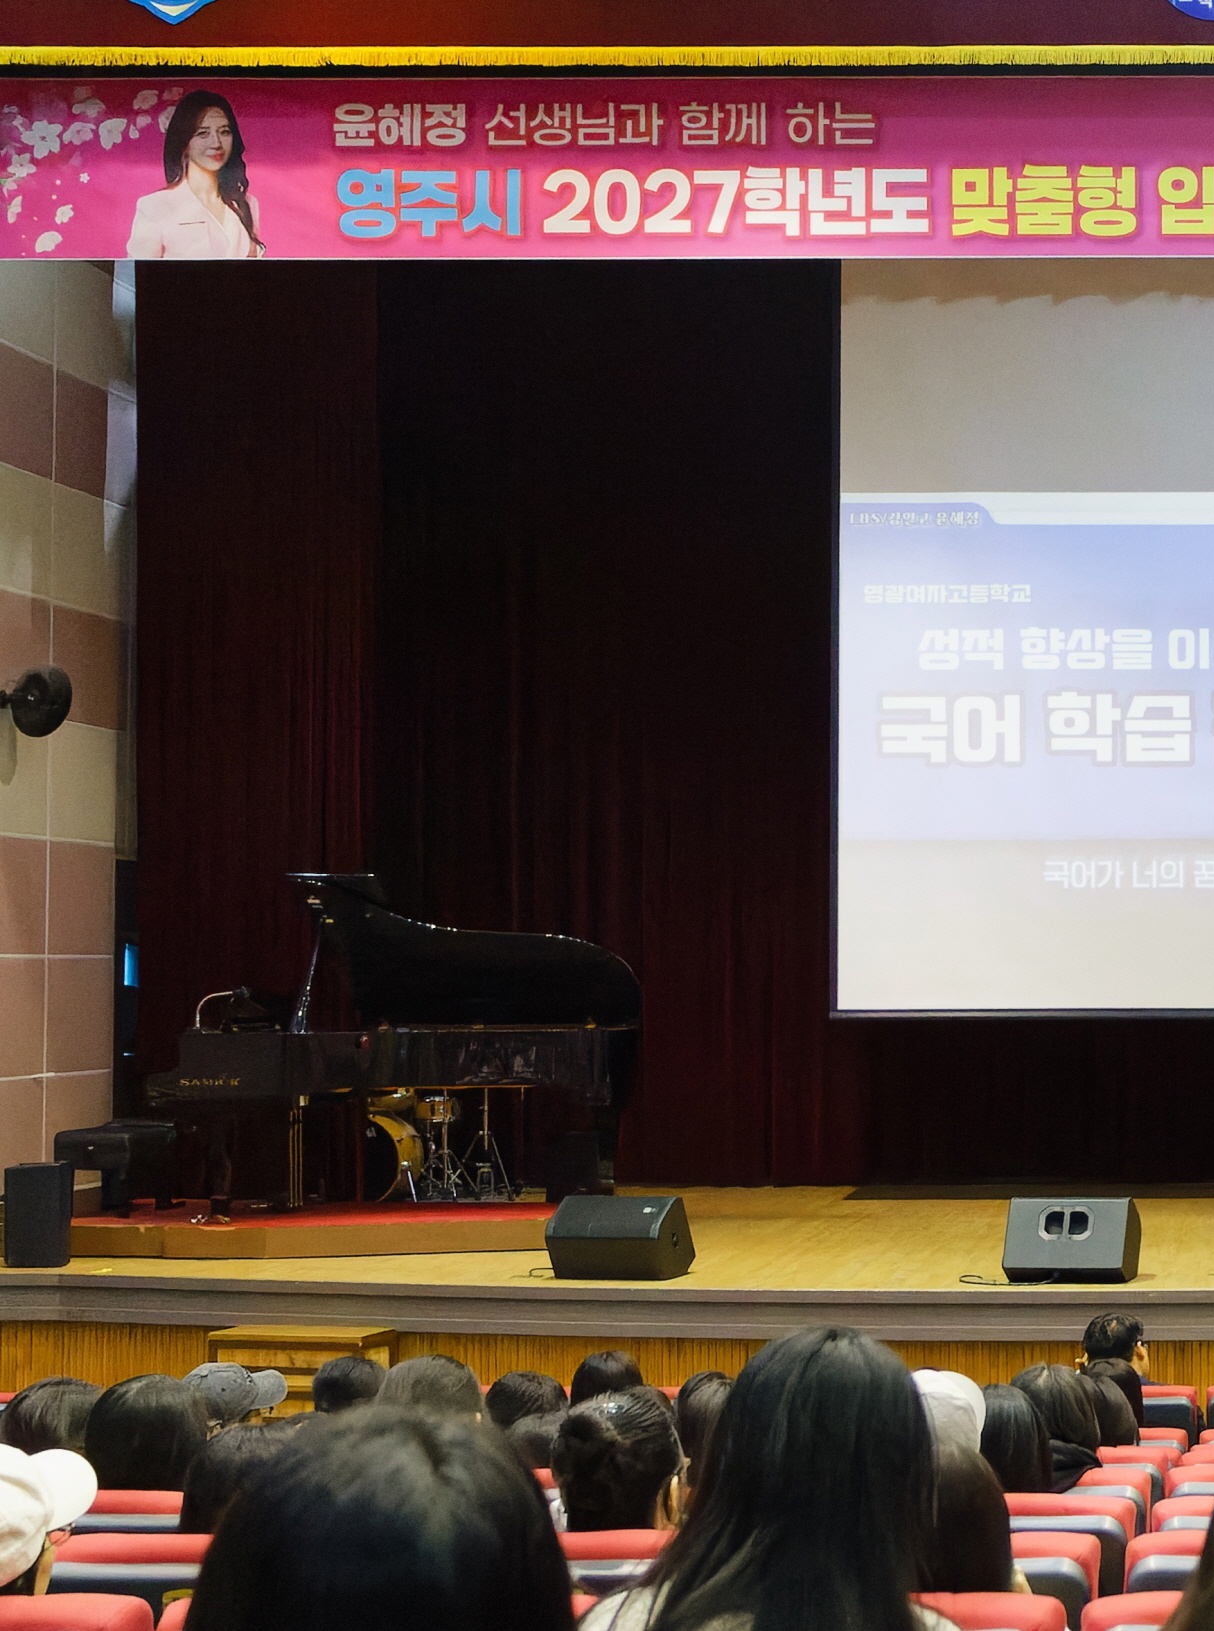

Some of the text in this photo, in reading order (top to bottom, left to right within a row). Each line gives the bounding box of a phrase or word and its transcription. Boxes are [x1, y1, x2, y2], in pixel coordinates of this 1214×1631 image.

[332, 100, 876, 147] 윤혜정 선생님과 함께 하는
[336, 166, 523, 239] 영주시
[542, 165, 929, 237] 2027학년도
[951, 164, 1137, 237] 맞춤형
[863, 583, 1032, 604] 영광여자고등학교
[917, 627, 1005, 671] 성적
[1019, 625, 1153, 671] 향상을
[878, 692, 1022, 765] 국어
[1045, 689, 1194, 764] 학습
[1042, 858, 1125, 889] 국어가
[1131, 858, 1185, 889] 너의
